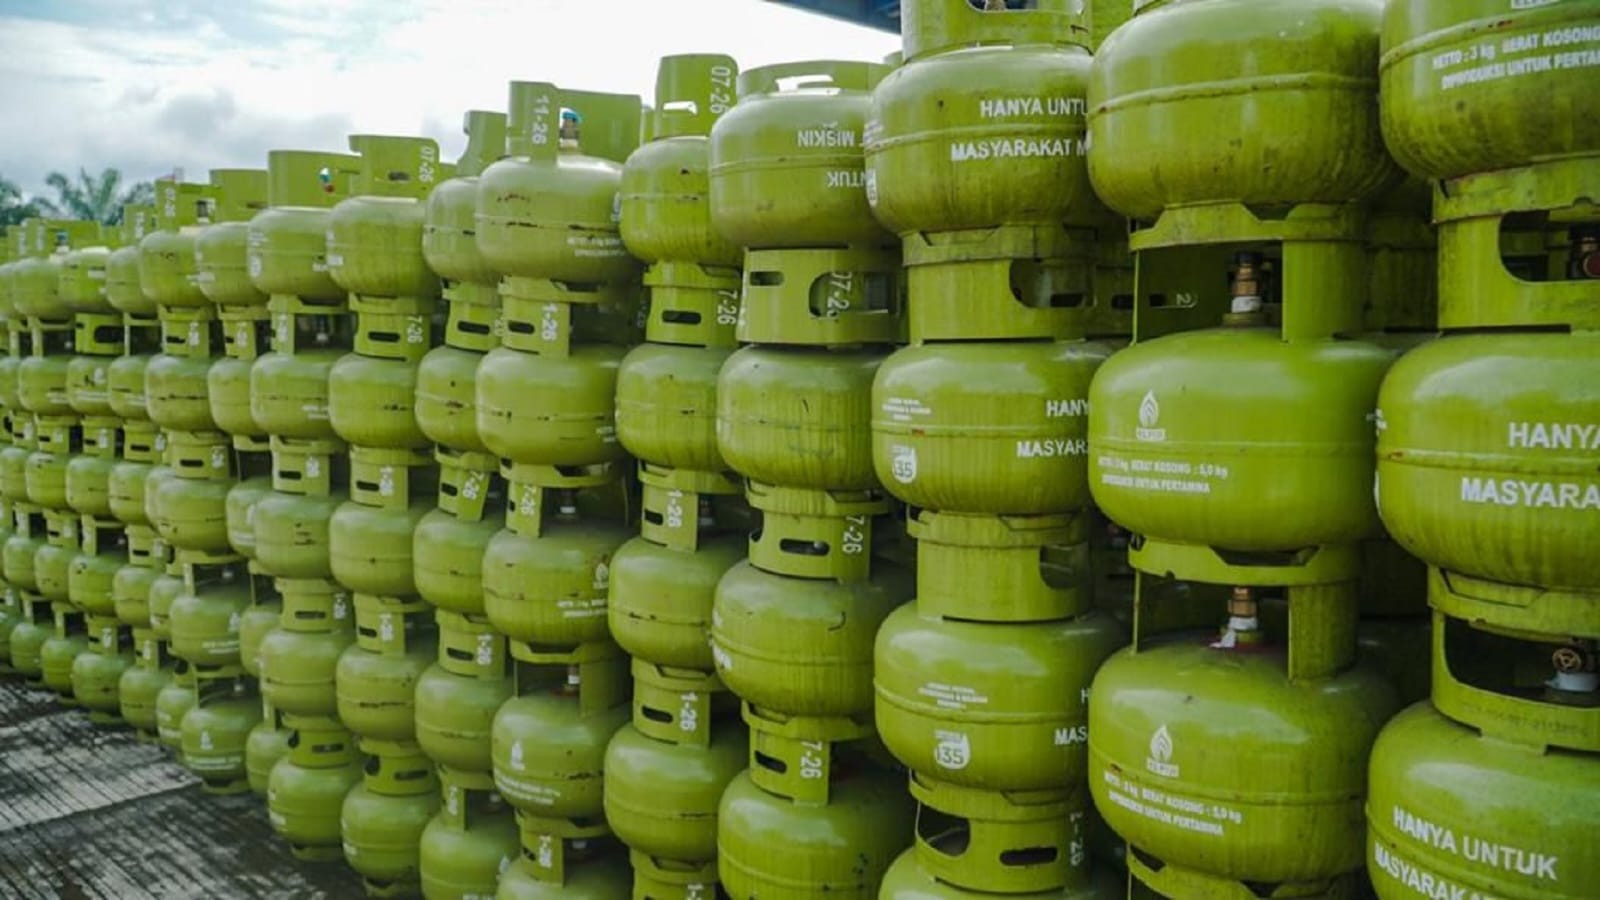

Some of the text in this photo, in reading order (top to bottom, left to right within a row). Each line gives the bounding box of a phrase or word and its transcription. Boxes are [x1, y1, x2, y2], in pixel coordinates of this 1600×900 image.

[711, 66, 731, 114] 07-26
[980, 98, 1043, 117] HANYA
[798, 130, 855, 148] MISKIN
[951, 139, 1071, 161] MASYARAKAT
[1392, 805, 1558, 881] HANYA UNTUK
